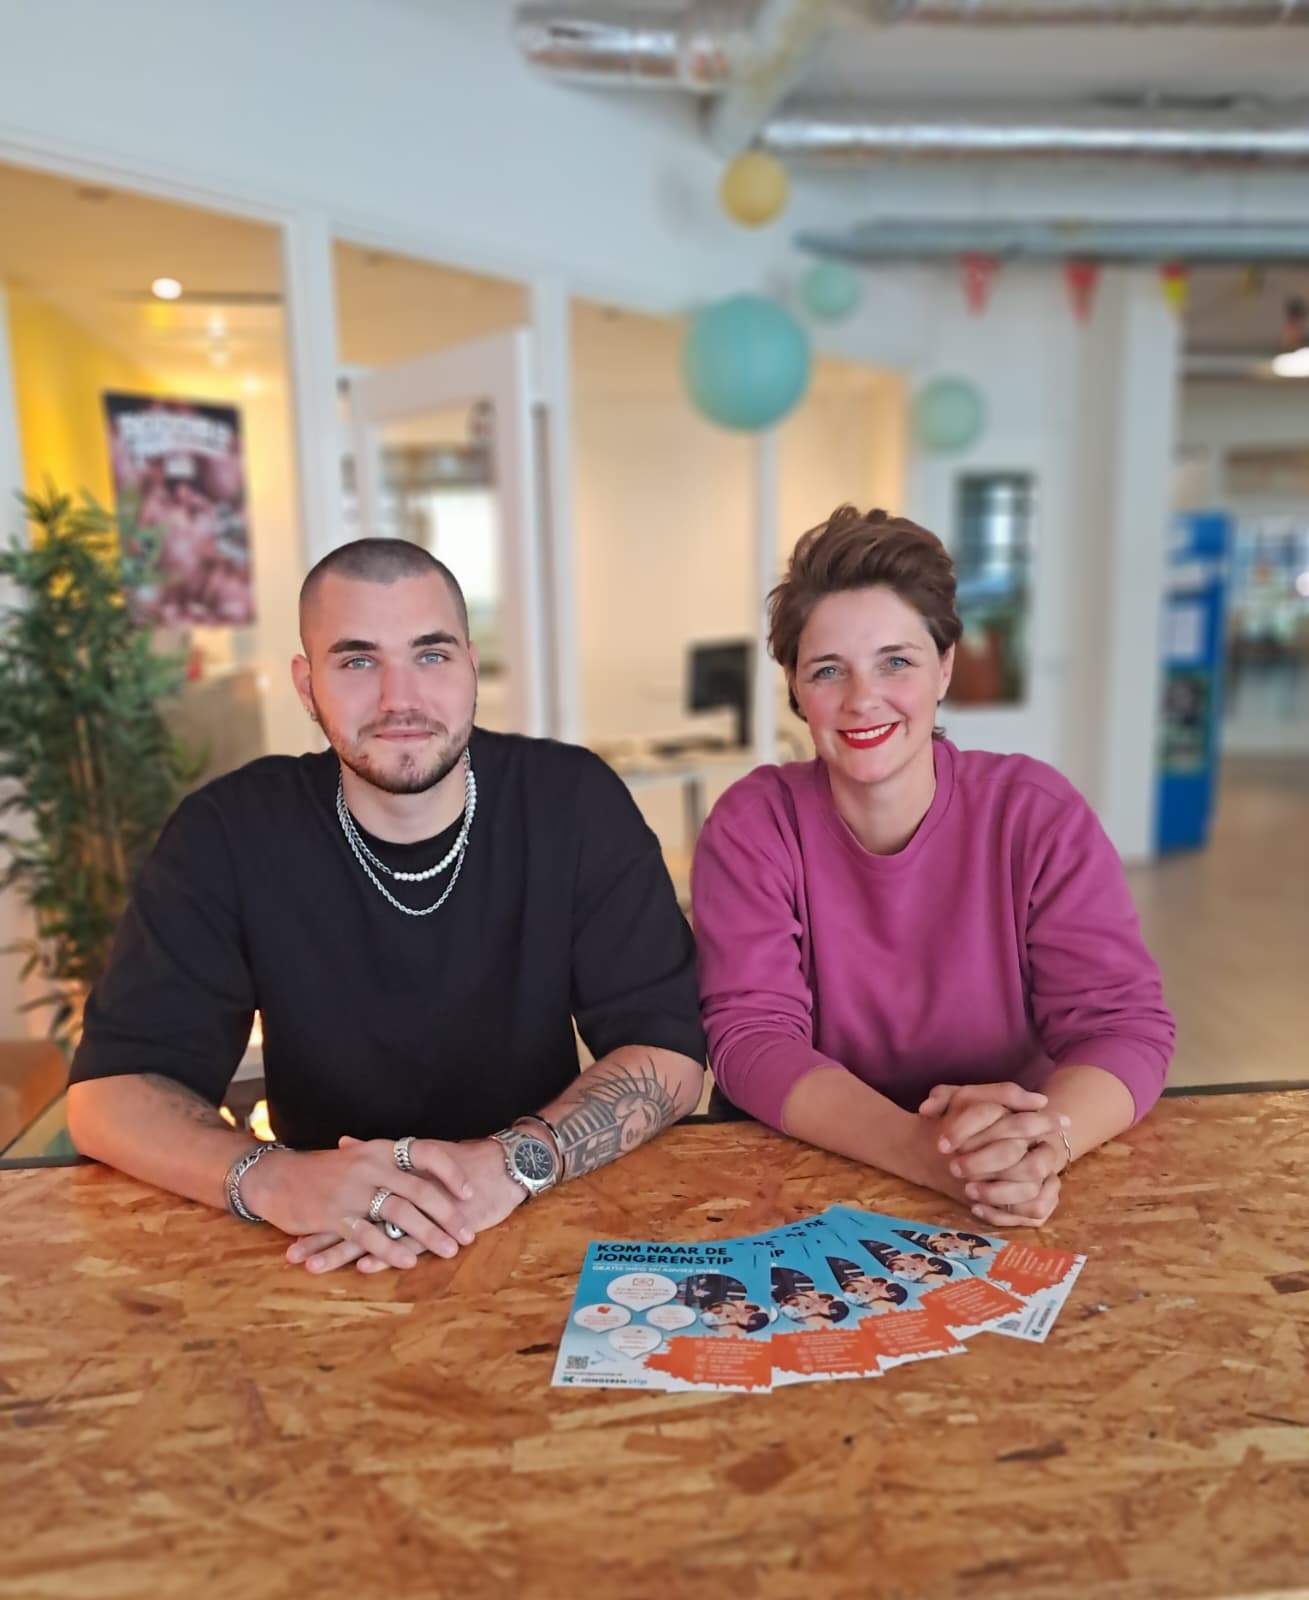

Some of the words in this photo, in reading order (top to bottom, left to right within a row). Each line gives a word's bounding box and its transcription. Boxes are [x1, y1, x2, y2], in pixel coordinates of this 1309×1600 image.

[597, 1244, 641, 1253] KOM
[646, 1245, 699, 1255] NAAR
[705, 1247, 728, 1256] DE
[593, 1253, 735, 1265] JONGERENSTIP
